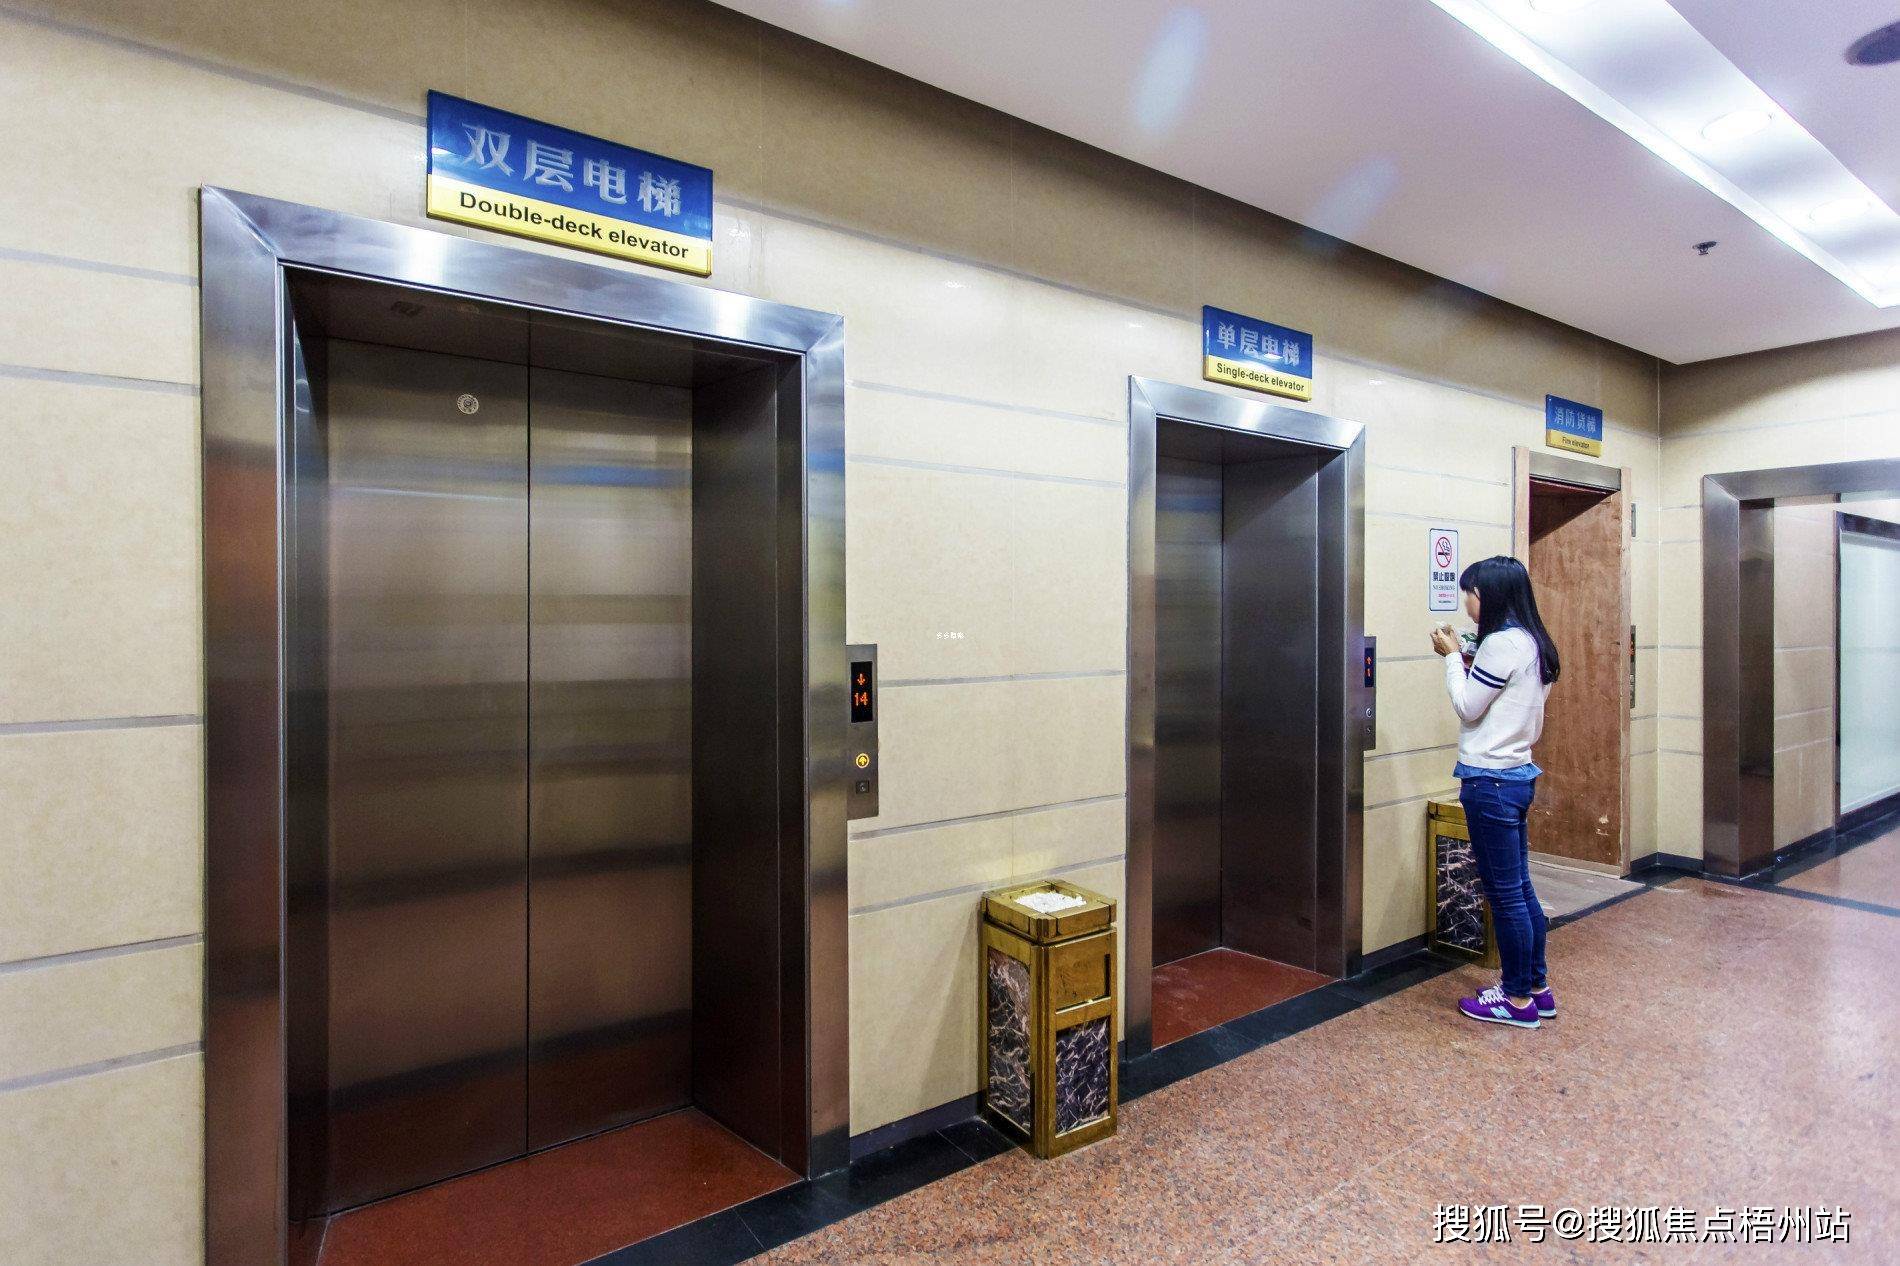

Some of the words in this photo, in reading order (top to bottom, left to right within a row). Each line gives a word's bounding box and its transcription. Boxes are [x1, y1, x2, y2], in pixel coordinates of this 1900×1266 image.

[461, 123, 682, 218] 双层电梯
[460, 191, 603, 240] Double-deck
[609, 229, 689, 259] elevator
[1216, 321, 1301, 367] 单层电梯
[1216, 362, 1270, 385] Single-deck
[1271, 377, 1305, 392] elevator
[854, 692, 868, 706] 14
